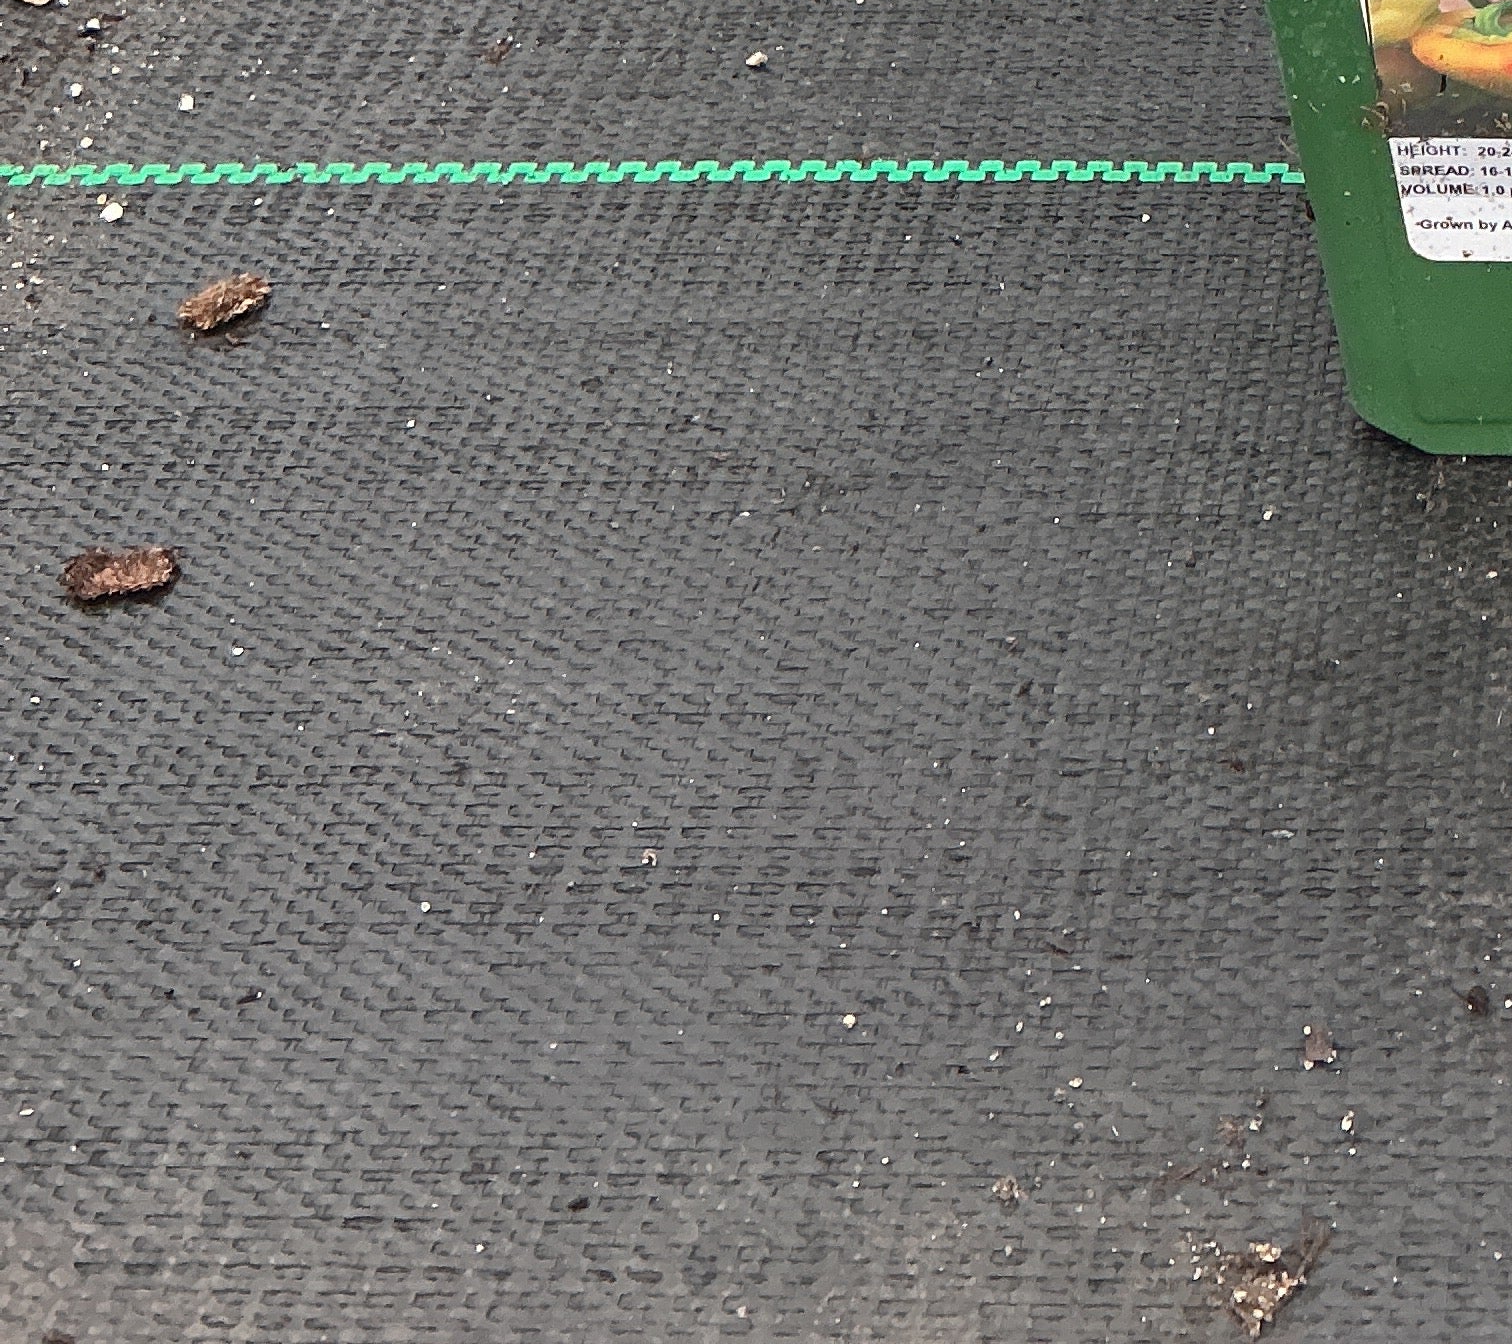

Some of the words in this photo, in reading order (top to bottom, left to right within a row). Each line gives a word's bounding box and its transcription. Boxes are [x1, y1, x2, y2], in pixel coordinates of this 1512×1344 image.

[1397, 145, 1468, 158] HEIGHT:
[1400, 164, 1475, 177] SPREAD:
[1482, 185, 1505, 196] 1.0
[1478, 219, 1498, 233] by
